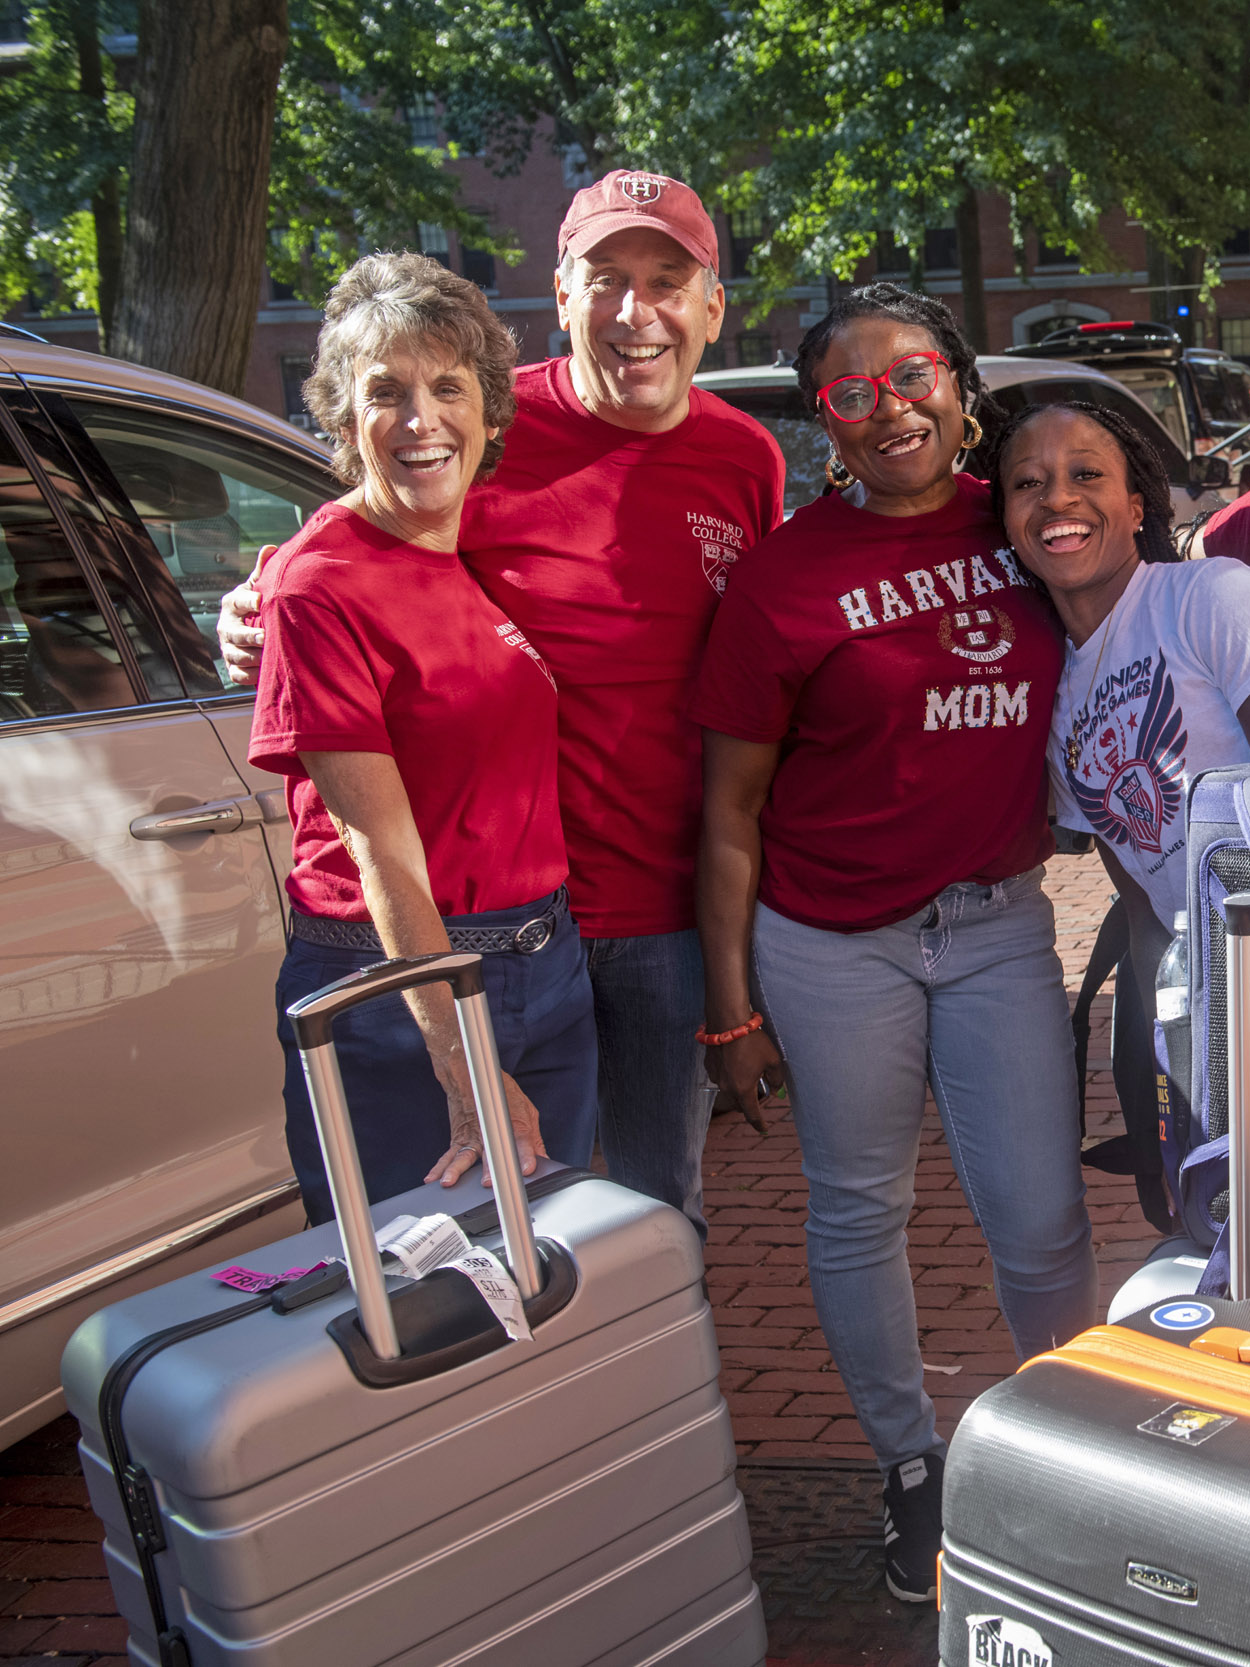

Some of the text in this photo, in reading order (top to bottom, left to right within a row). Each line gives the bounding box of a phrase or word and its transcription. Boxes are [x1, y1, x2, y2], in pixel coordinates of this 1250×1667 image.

[631, 182, 650, 197] H
[686, 511, 744, 539] HARVARD
[692, 526, 743, 549] COLLEGE
[837, 547, 1030, 631] HARVAR
[984, 665, 1003, 675] 1636
[1094, 656, 1152, 712] JUNIOR
[923, 681, 1032, 731] MOM
[1108, 679, 1151, 713] GAMES
[1120, 777, 1139, 798] AAU
[1128, 804, 1152, 821] USA
[461, 1257, 493, 1269] BOS
